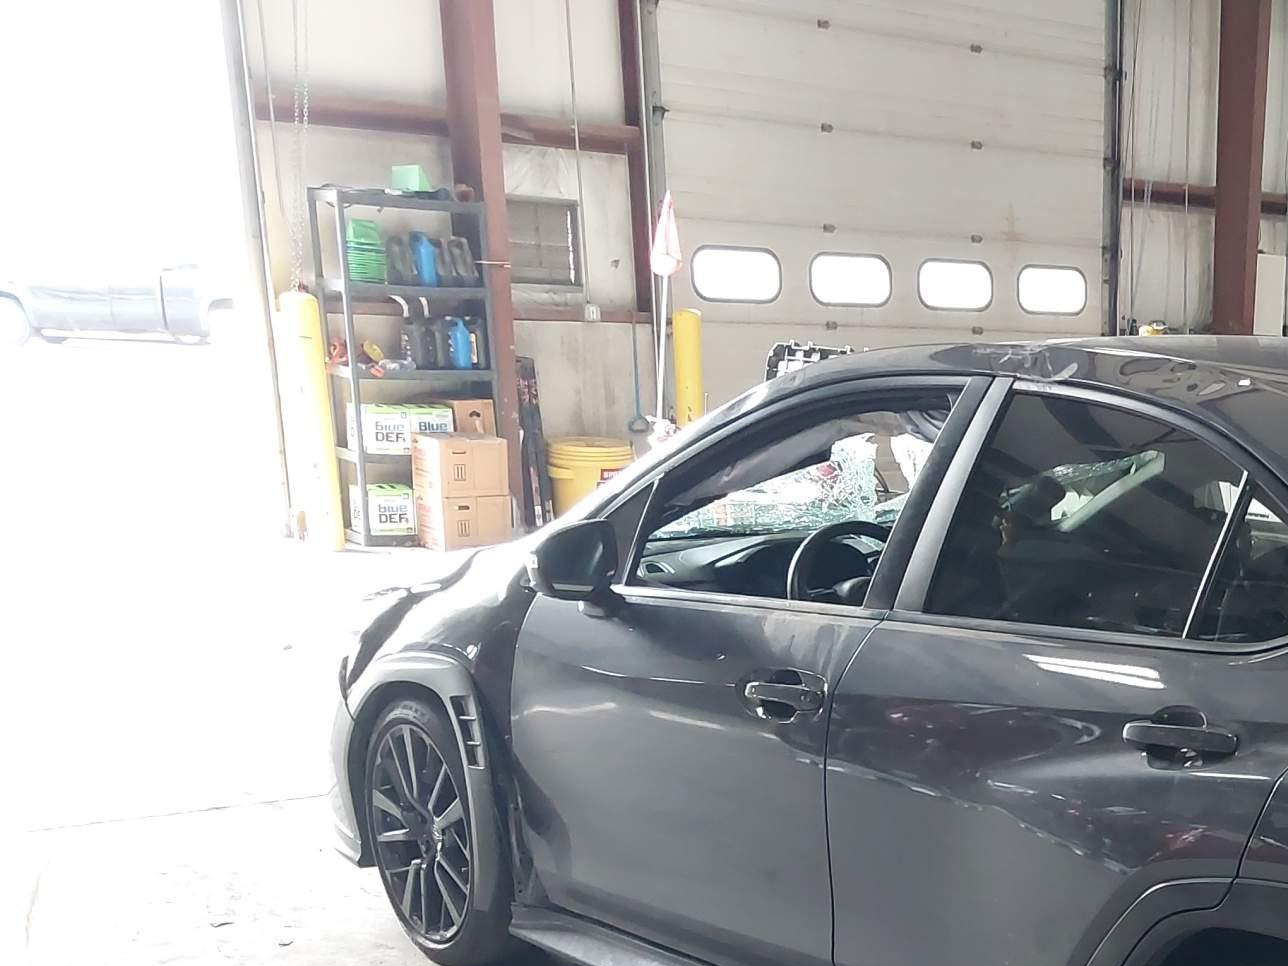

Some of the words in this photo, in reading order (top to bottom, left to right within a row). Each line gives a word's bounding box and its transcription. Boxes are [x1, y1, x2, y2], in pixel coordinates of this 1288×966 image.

[418, 420, 449, 433] Blue
[375, 431, 405, 442] DEF
[378, 513, 408, 524] DEF
